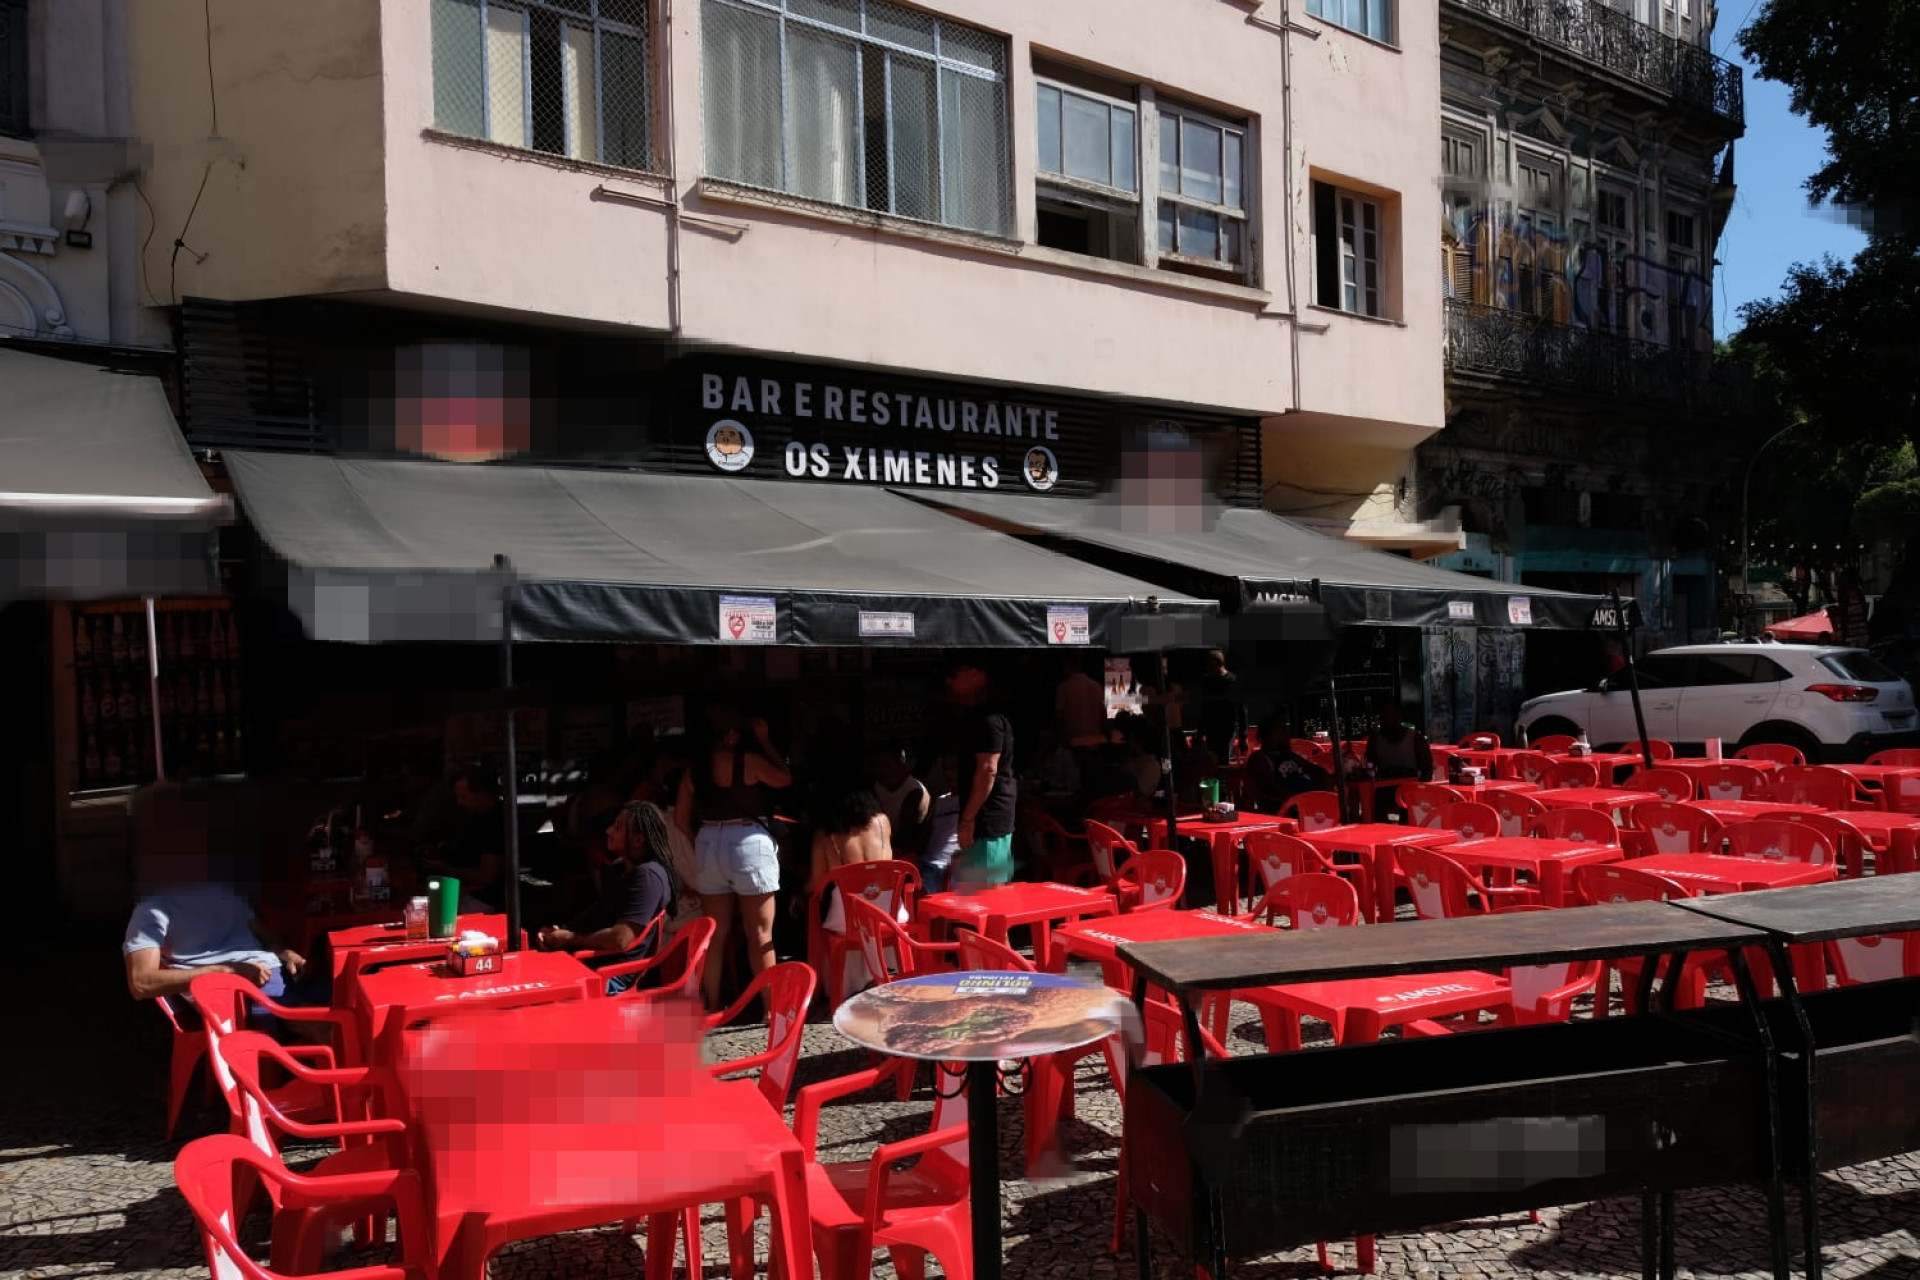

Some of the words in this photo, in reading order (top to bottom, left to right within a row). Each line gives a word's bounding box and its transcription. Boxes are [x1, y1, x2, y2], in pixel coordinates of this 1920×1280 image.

[702, 373, 782, 416] BAR
[795, 383, 813, 417] E
[824, 385, 1060, 441] RESTAURANTE
[785, 441, 831, 478] OS
[842, 445, 1000, 489] XIMENES
[475, 958, 493, 971] 44
